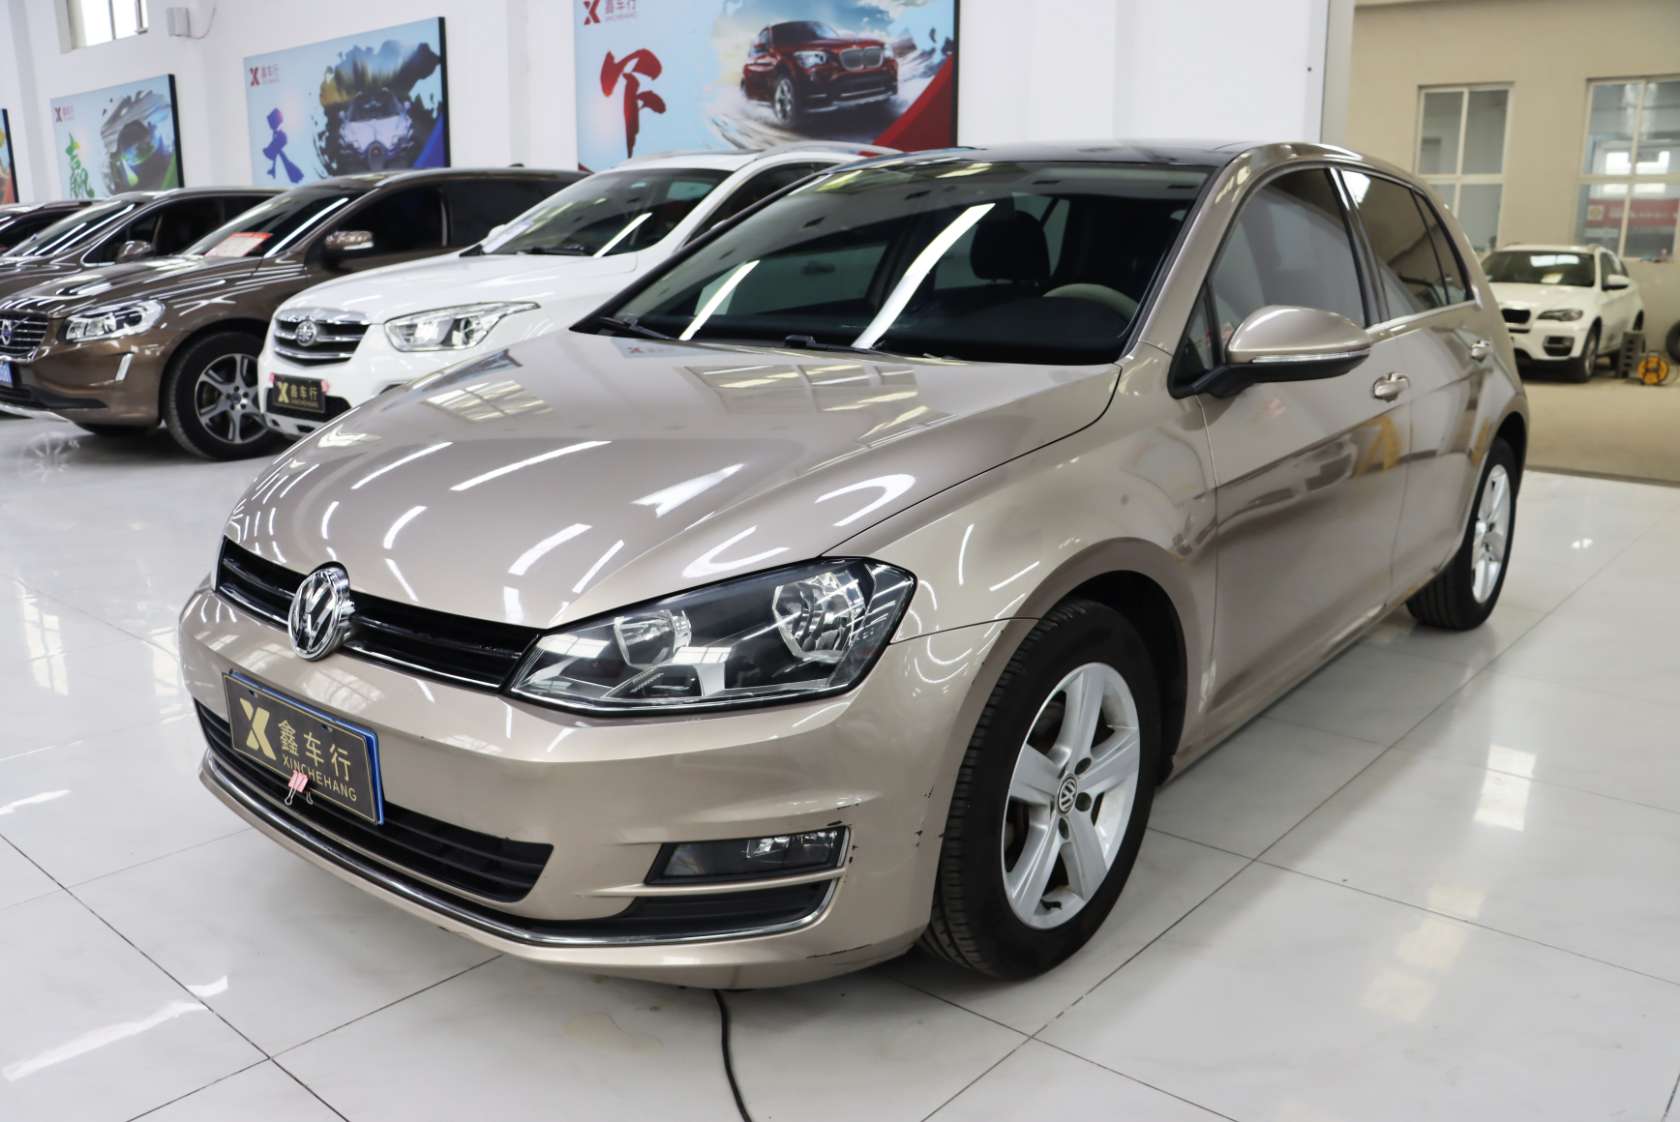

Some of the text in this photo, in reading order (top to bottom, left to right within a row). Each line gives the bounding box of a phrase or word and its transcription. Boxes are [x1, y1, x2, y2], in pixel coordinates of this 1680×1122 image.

[239, 697, 277, 760] X
[277, 719, 352, 782] 鑫车行
[282, 754, 358, 802] XINCHEHANG
